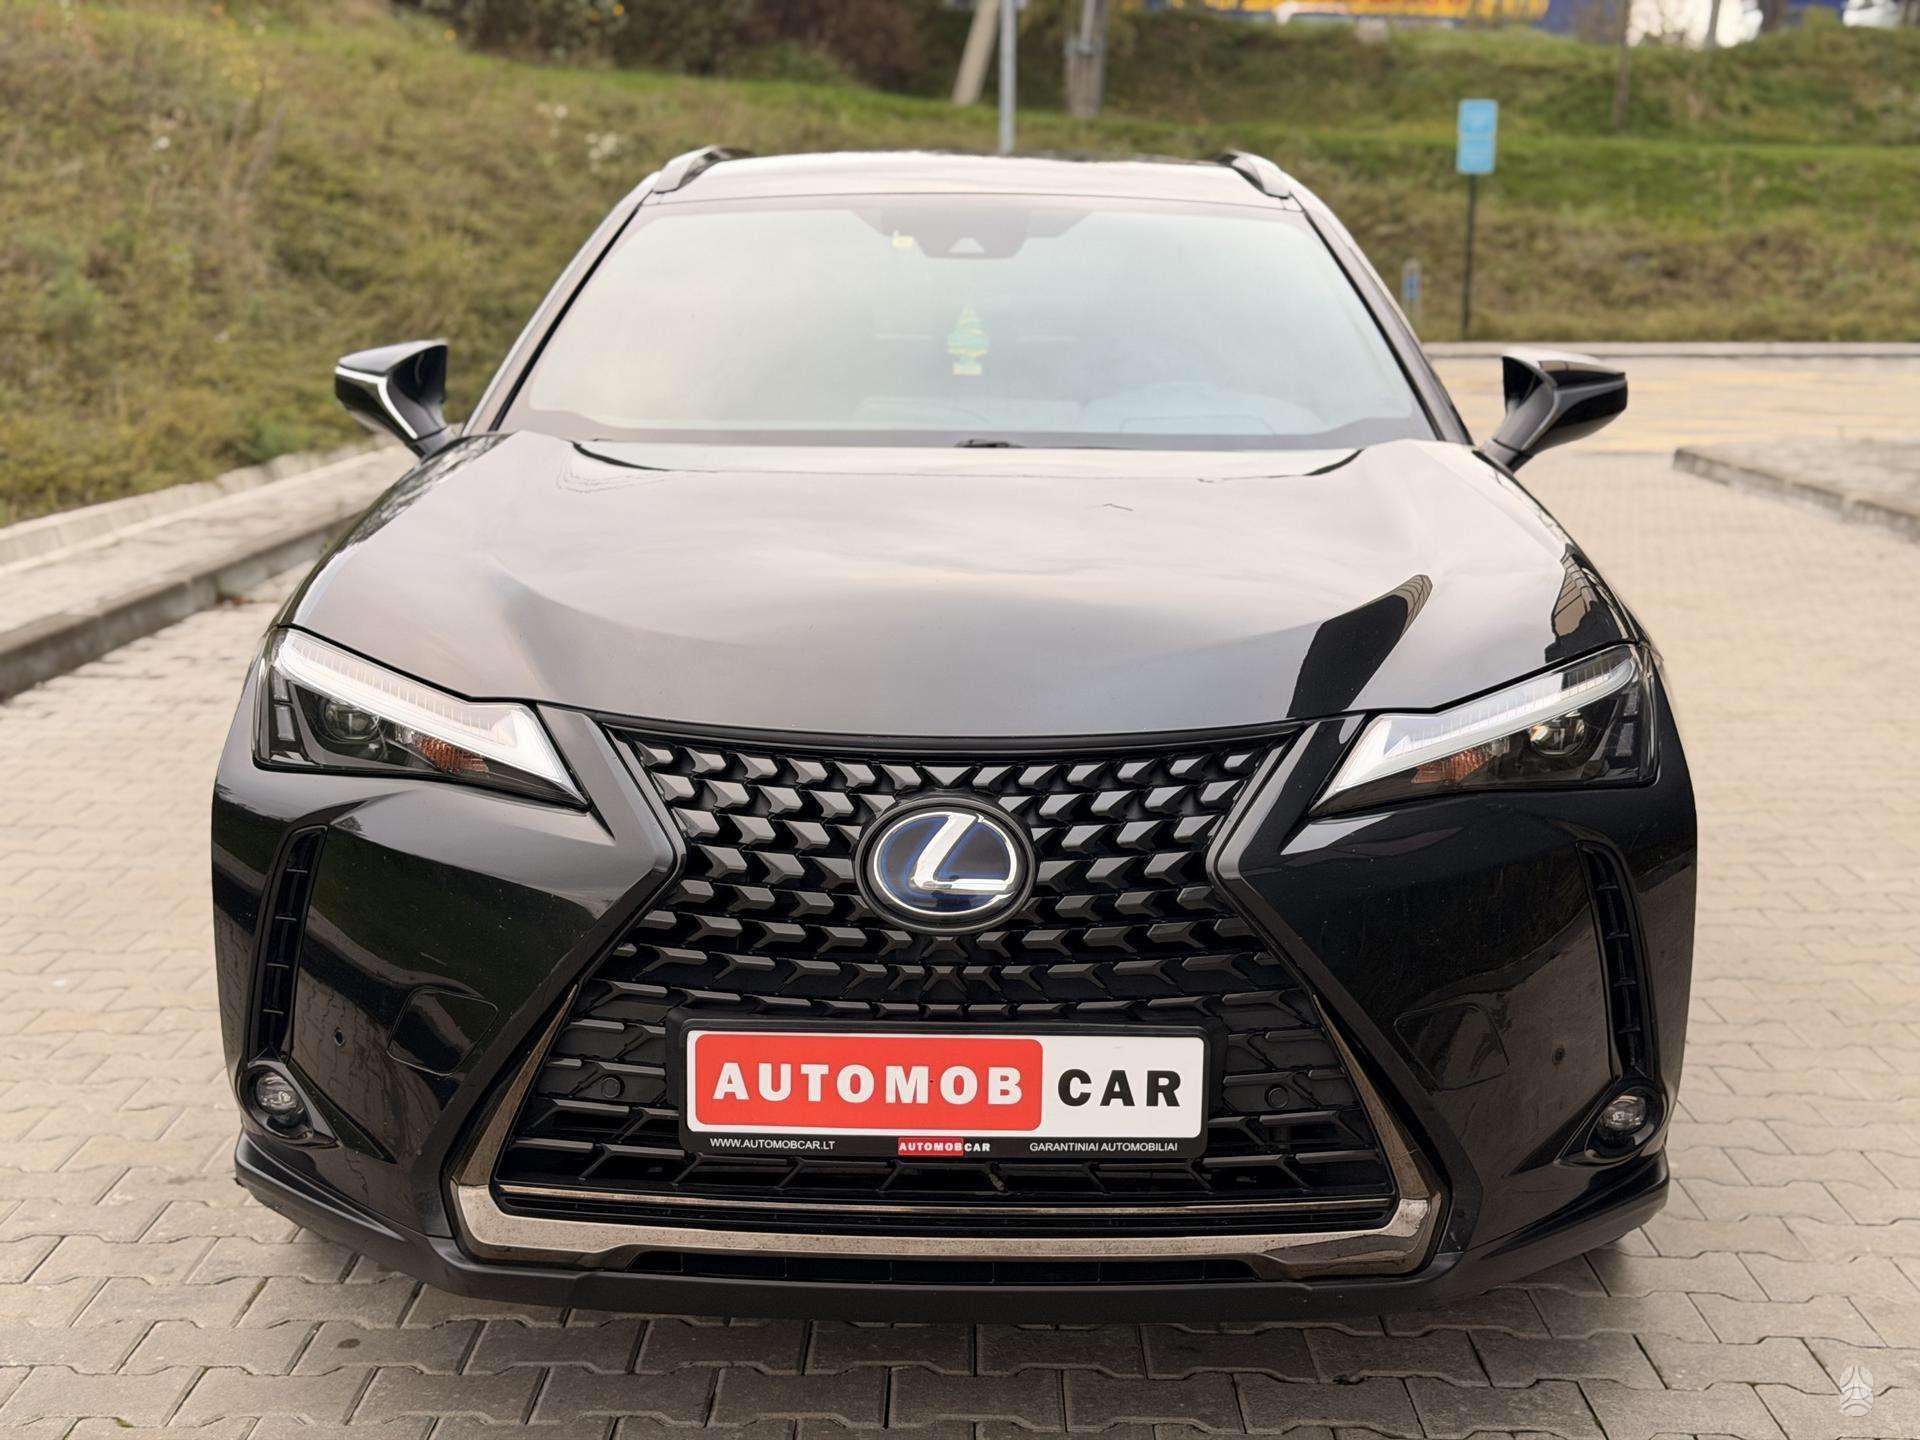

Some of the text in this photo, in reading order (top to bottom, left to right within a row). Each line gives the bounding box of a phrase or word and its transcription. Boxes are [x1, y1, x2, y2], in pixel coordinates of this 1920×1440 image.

[712, 1062, 1181, 1107] AUTOMOB CAR
[709, 1137, 835, 1150] WWW.AUTOMOBCAR.LT
[1030, 1143, 1178, 1152] GARANTINIAI AUTOMOBILIAI
